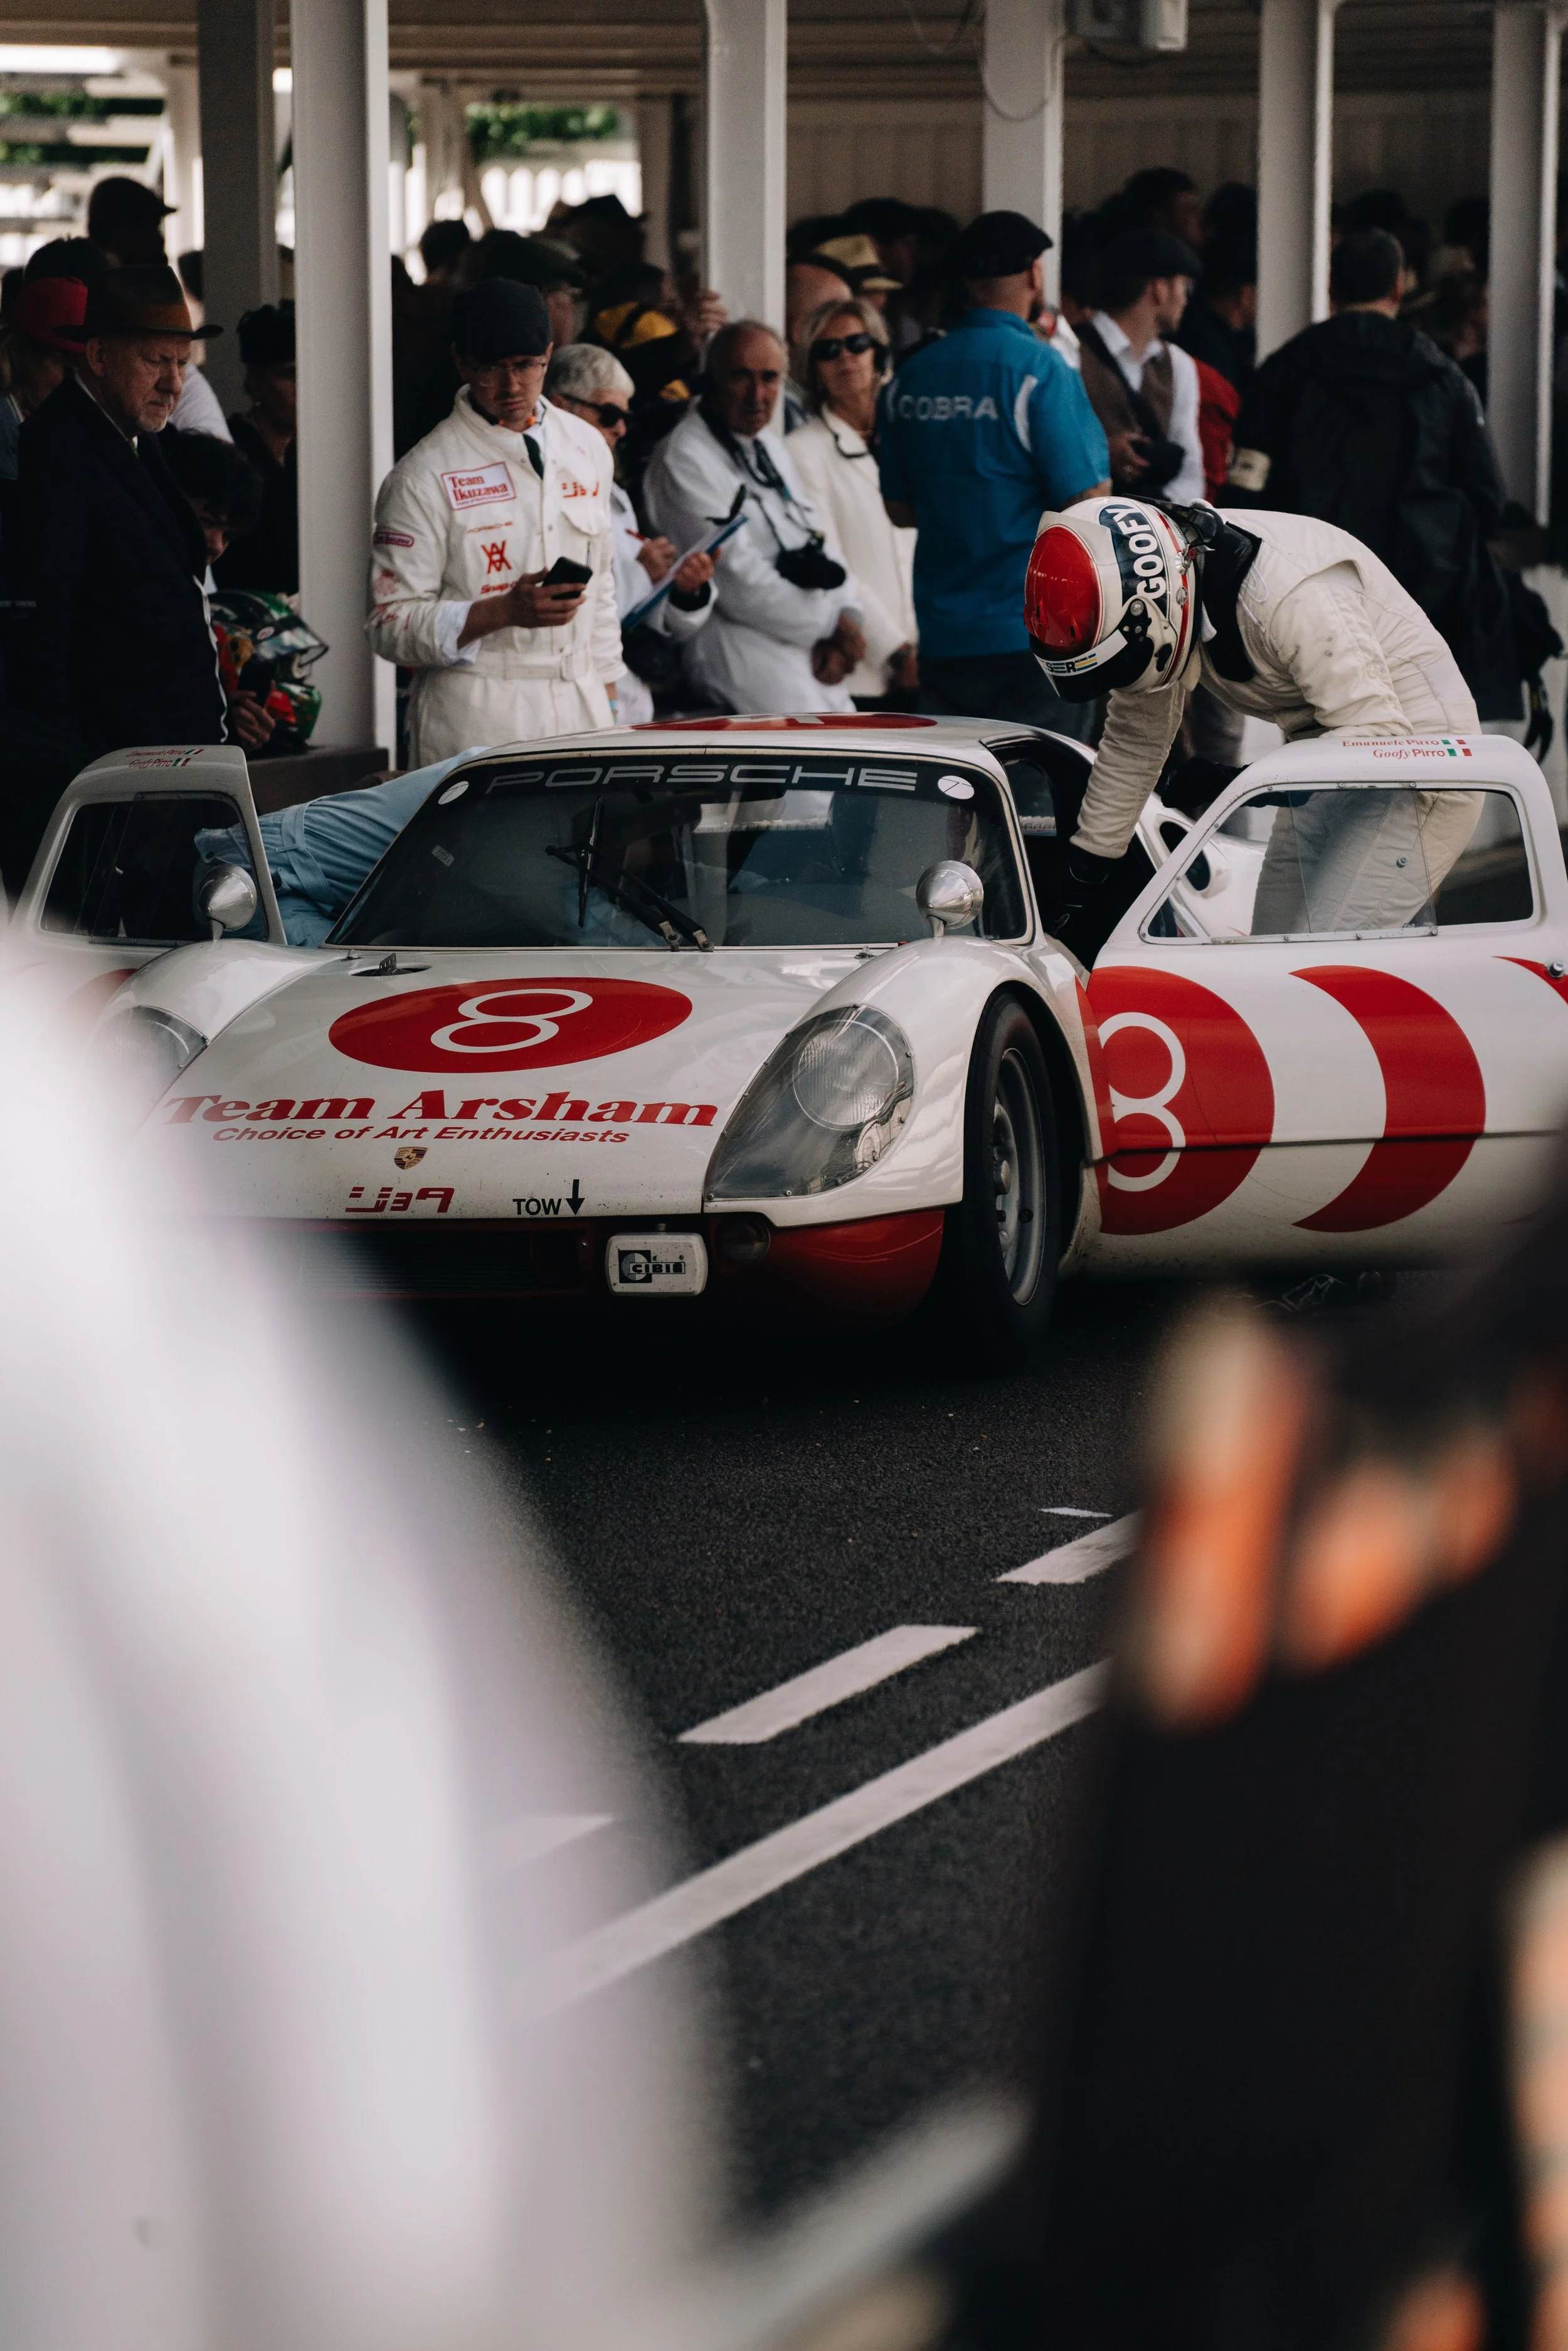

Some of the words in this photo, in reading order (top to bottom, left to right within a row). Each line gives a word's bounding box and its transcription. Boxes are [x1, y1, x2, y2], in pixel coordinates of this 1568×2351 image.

[898, 395, 999, 421] COBRA
[448, 475, 485, 488] Team
[452, 482, 508, 502] Ikuzawa
[1106, 507, 1167, 600] GOOFY
[1342, 739, 1406, 747] Emanuele
[151, 758, 173, 767] Pirro
[1373, 748, 1411, 760] Goofy
[1412, 748, 1446, 758] Pirro
[485, 763, 918, 795] PORSCHE
[430, 988, 593, 1053] 8
[162, 1095, 376, 1125] Team
[386, 1089, 718, 1127] Arsham
[212, 1127, 326, 1141] Choice
[334, 1126, 374, 1139] of
[371, 1126, 429, 1139] Art
[433, 1126, 630, 1143] Enthusiasts
[512, 1199, 563, 1216] TOW
